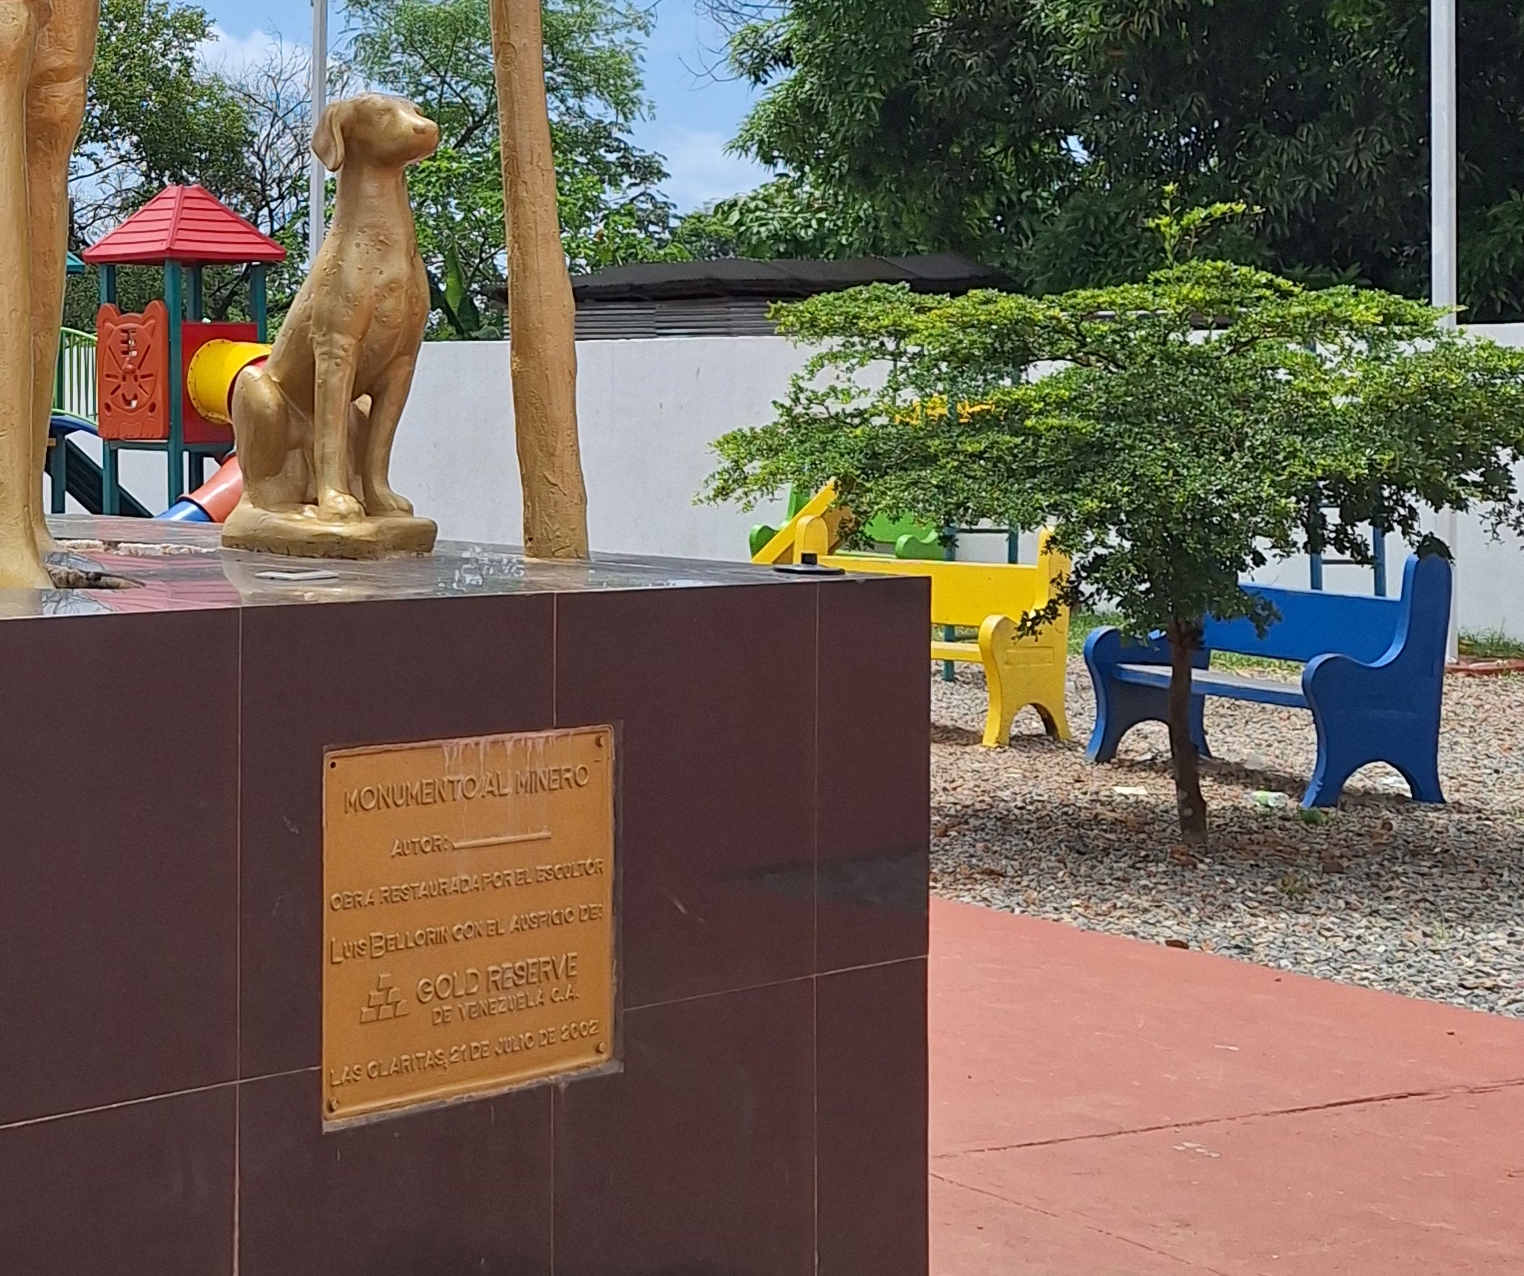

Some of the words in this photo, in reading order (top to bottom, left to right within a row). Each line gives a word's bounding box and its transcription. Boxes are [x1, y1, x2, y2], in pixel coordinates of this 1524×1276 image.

[344, 774, 476, 814] MONUMENTO
[481, 772, 512, 798] AL
[516, 764, 590, 793] MINERO
[391, 834, 449, 858] AUTOR:
[330, 889, 375, 912] OBRA
[380, 874, 479, 904] RESTAURADA
[481, 869, 511, 890] POR
[515, 868, 533, 886] EL
[536, 858, 604, 883] ESCULTOR
[330, 937, 367, 965] LUIS
[452, 922, 483, 942] CON
[486, 919, 505, 936] EL
[509, 906, 574, 934] AUSPICIO
[579, 903, 603, 922] DE:
[416, 968, 481, 1004] GOLD
[487, 952, 578, 993] RESERVE
[432, 1005, 452, 1026] DE
[458, 989, 545, 1021] VENEZUELA
[550, 984, 580, 1003] C.A.
[330, 1064, 362, 1087] LAS
[366, 1049, 449, 1079] CLARITAS,
[450, 1043, 466, 1063] 21
[471, 1041, 490, 1058] DE
[494, 1032, 534, 1056] JULIO
[539, 1028, 557, 1047] DE
[561, 1019, 600, 1042] 2002
